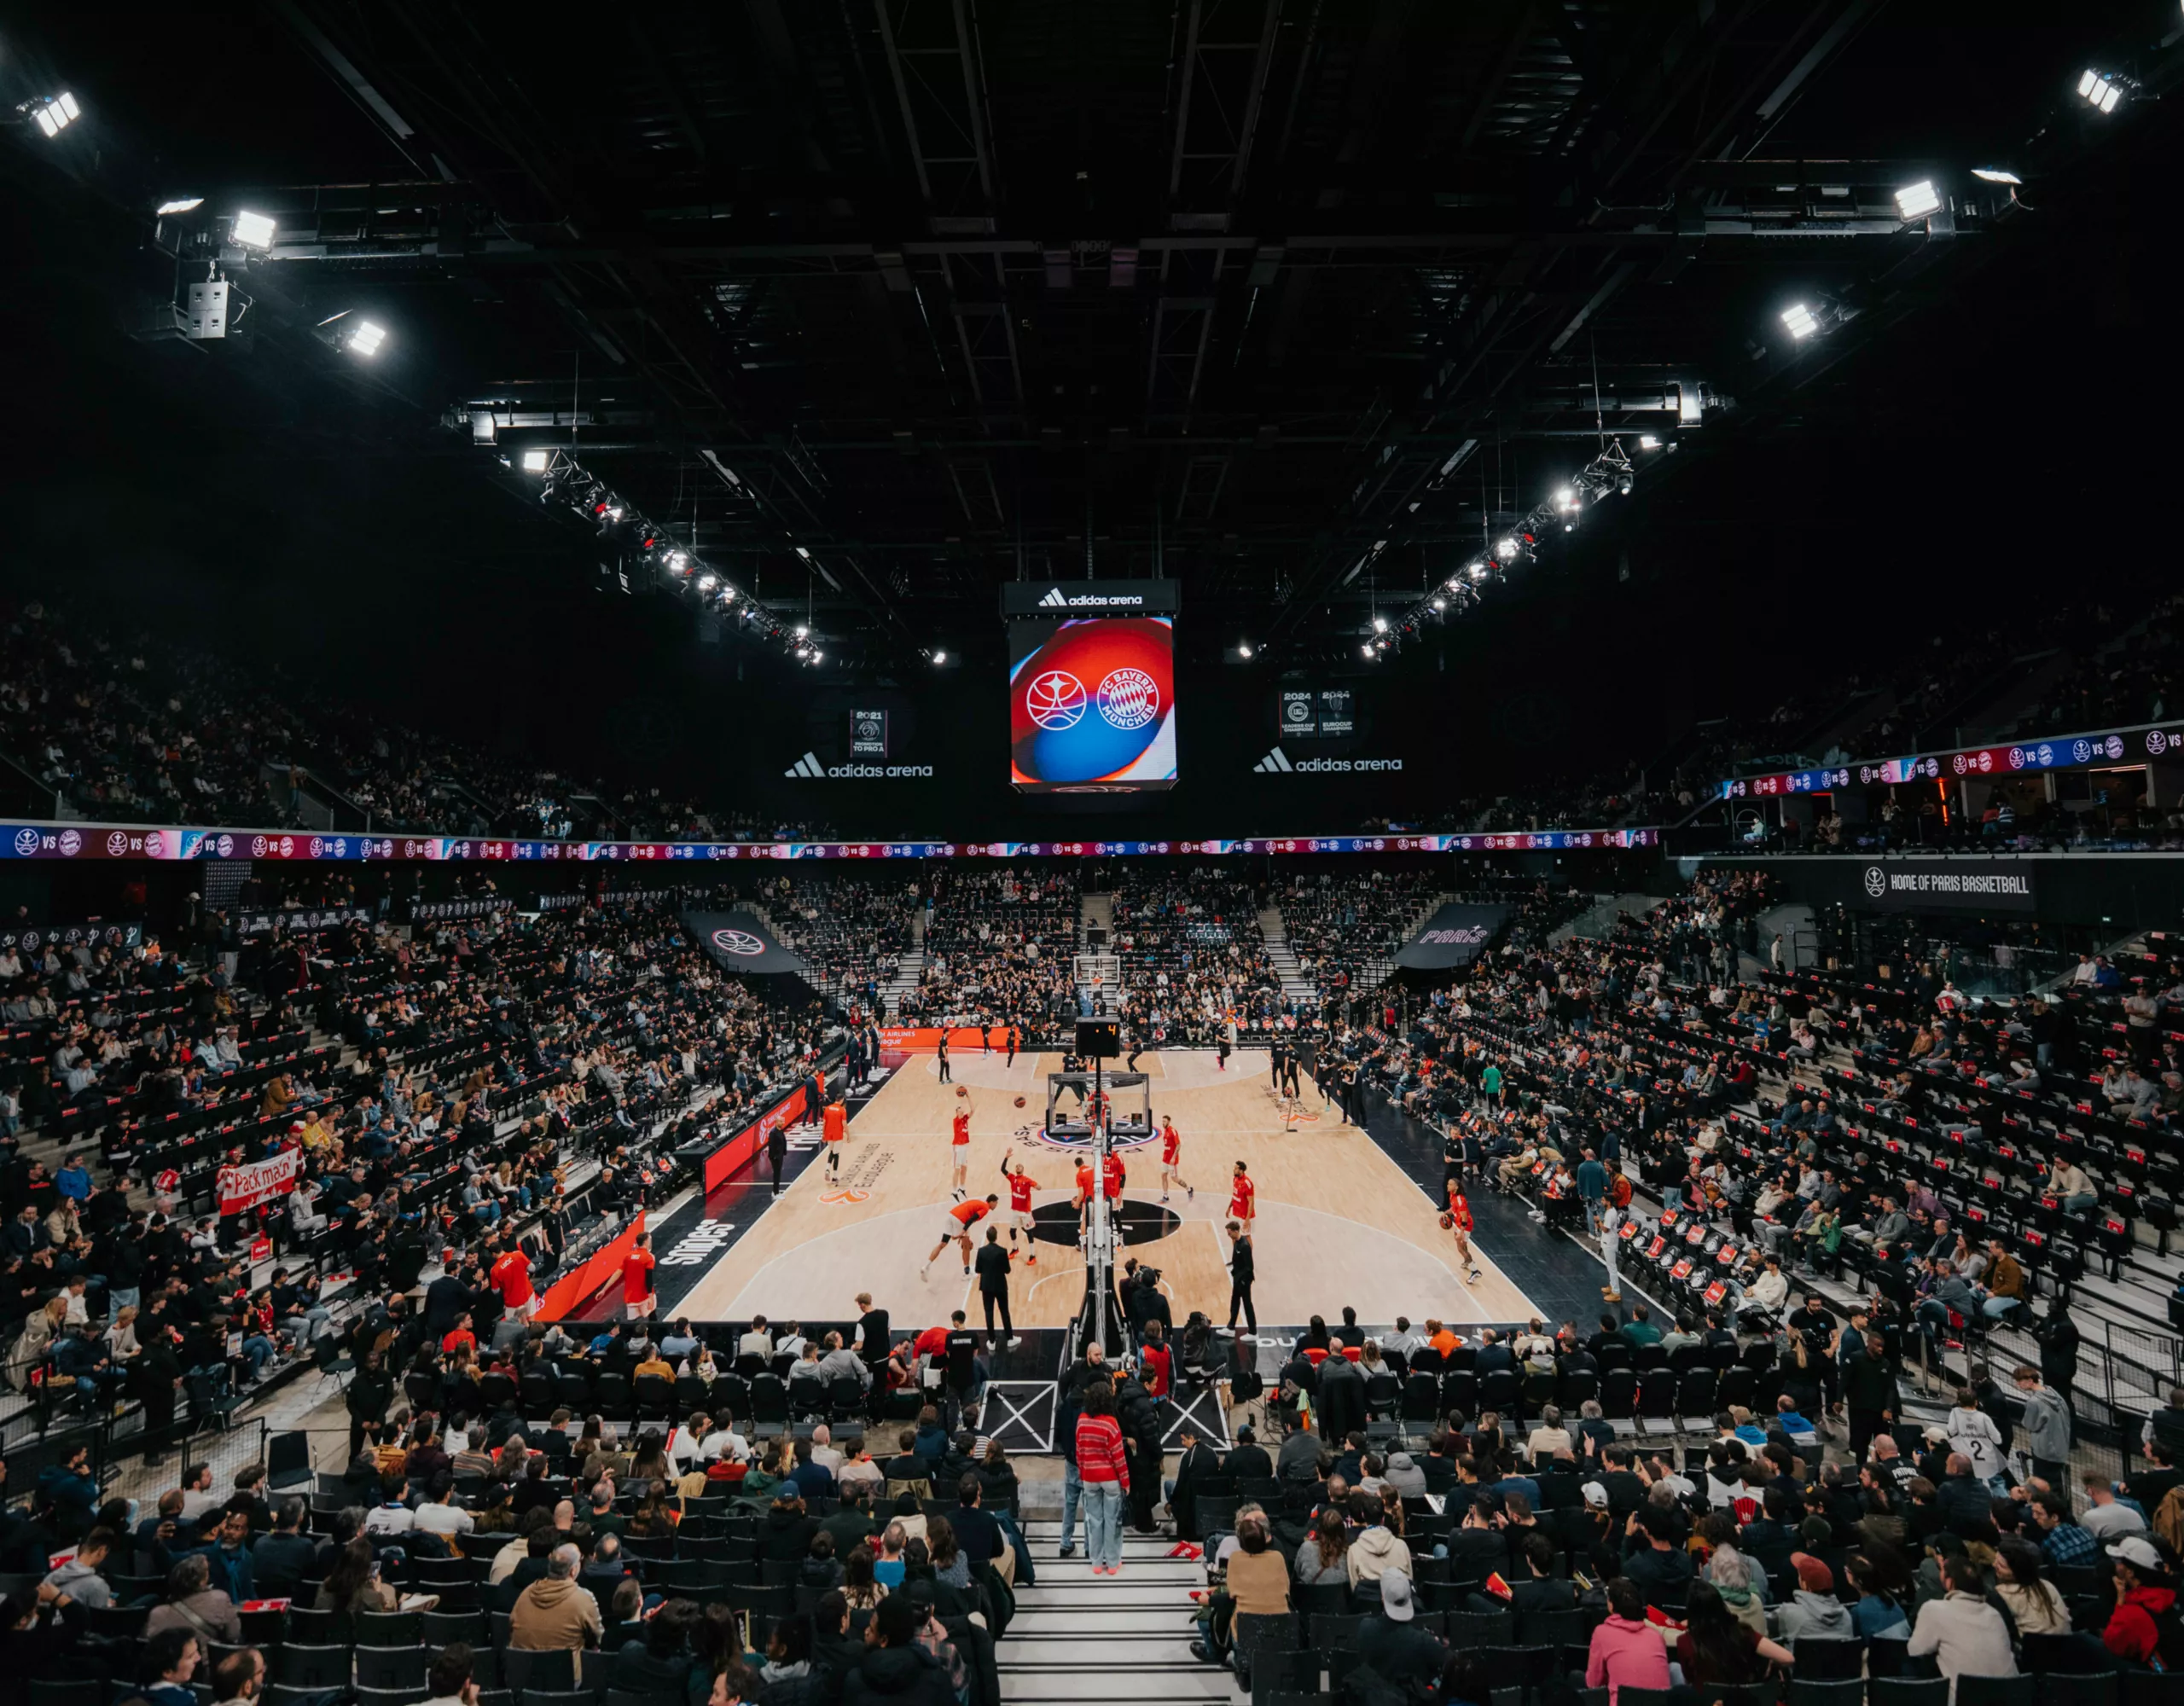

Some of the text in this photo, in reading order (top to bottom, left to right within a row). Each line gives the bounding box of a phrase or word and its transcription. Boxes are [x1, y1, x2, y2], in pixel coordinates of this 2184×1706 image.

[1069, 595, 1142, 606] adidas arena
[1101, 671, 1154, 695] FC BAYERN
[2169, 735, 2181, 746] VS
[2093, 744, 2103, 754] VS
[2027, 751, 2036, 762] VS
[1296, 758, 1402, 771] adidas arena
[1917, 764, 1925, 774] VS
[1968, 758, 1977, 768] VS
[828, 764, 932, 777] adidas arena
[43, 836, 56, 849] VS
[131, 838, 142, 850] VS
[205, 839, 215, 851] VS
[269, 841, 278, 852] VS
[325, 843, 333, 853] VS
[374, 844, 381, 853] VS
[1891, 874, 2030, 894] HOME OF PARIS BASKETBALL
[1420, 928, 1488, 944] PARIS
[659, 1220, 735, 1266] snipes
[1970, 1440, 1985, 1461] 2
